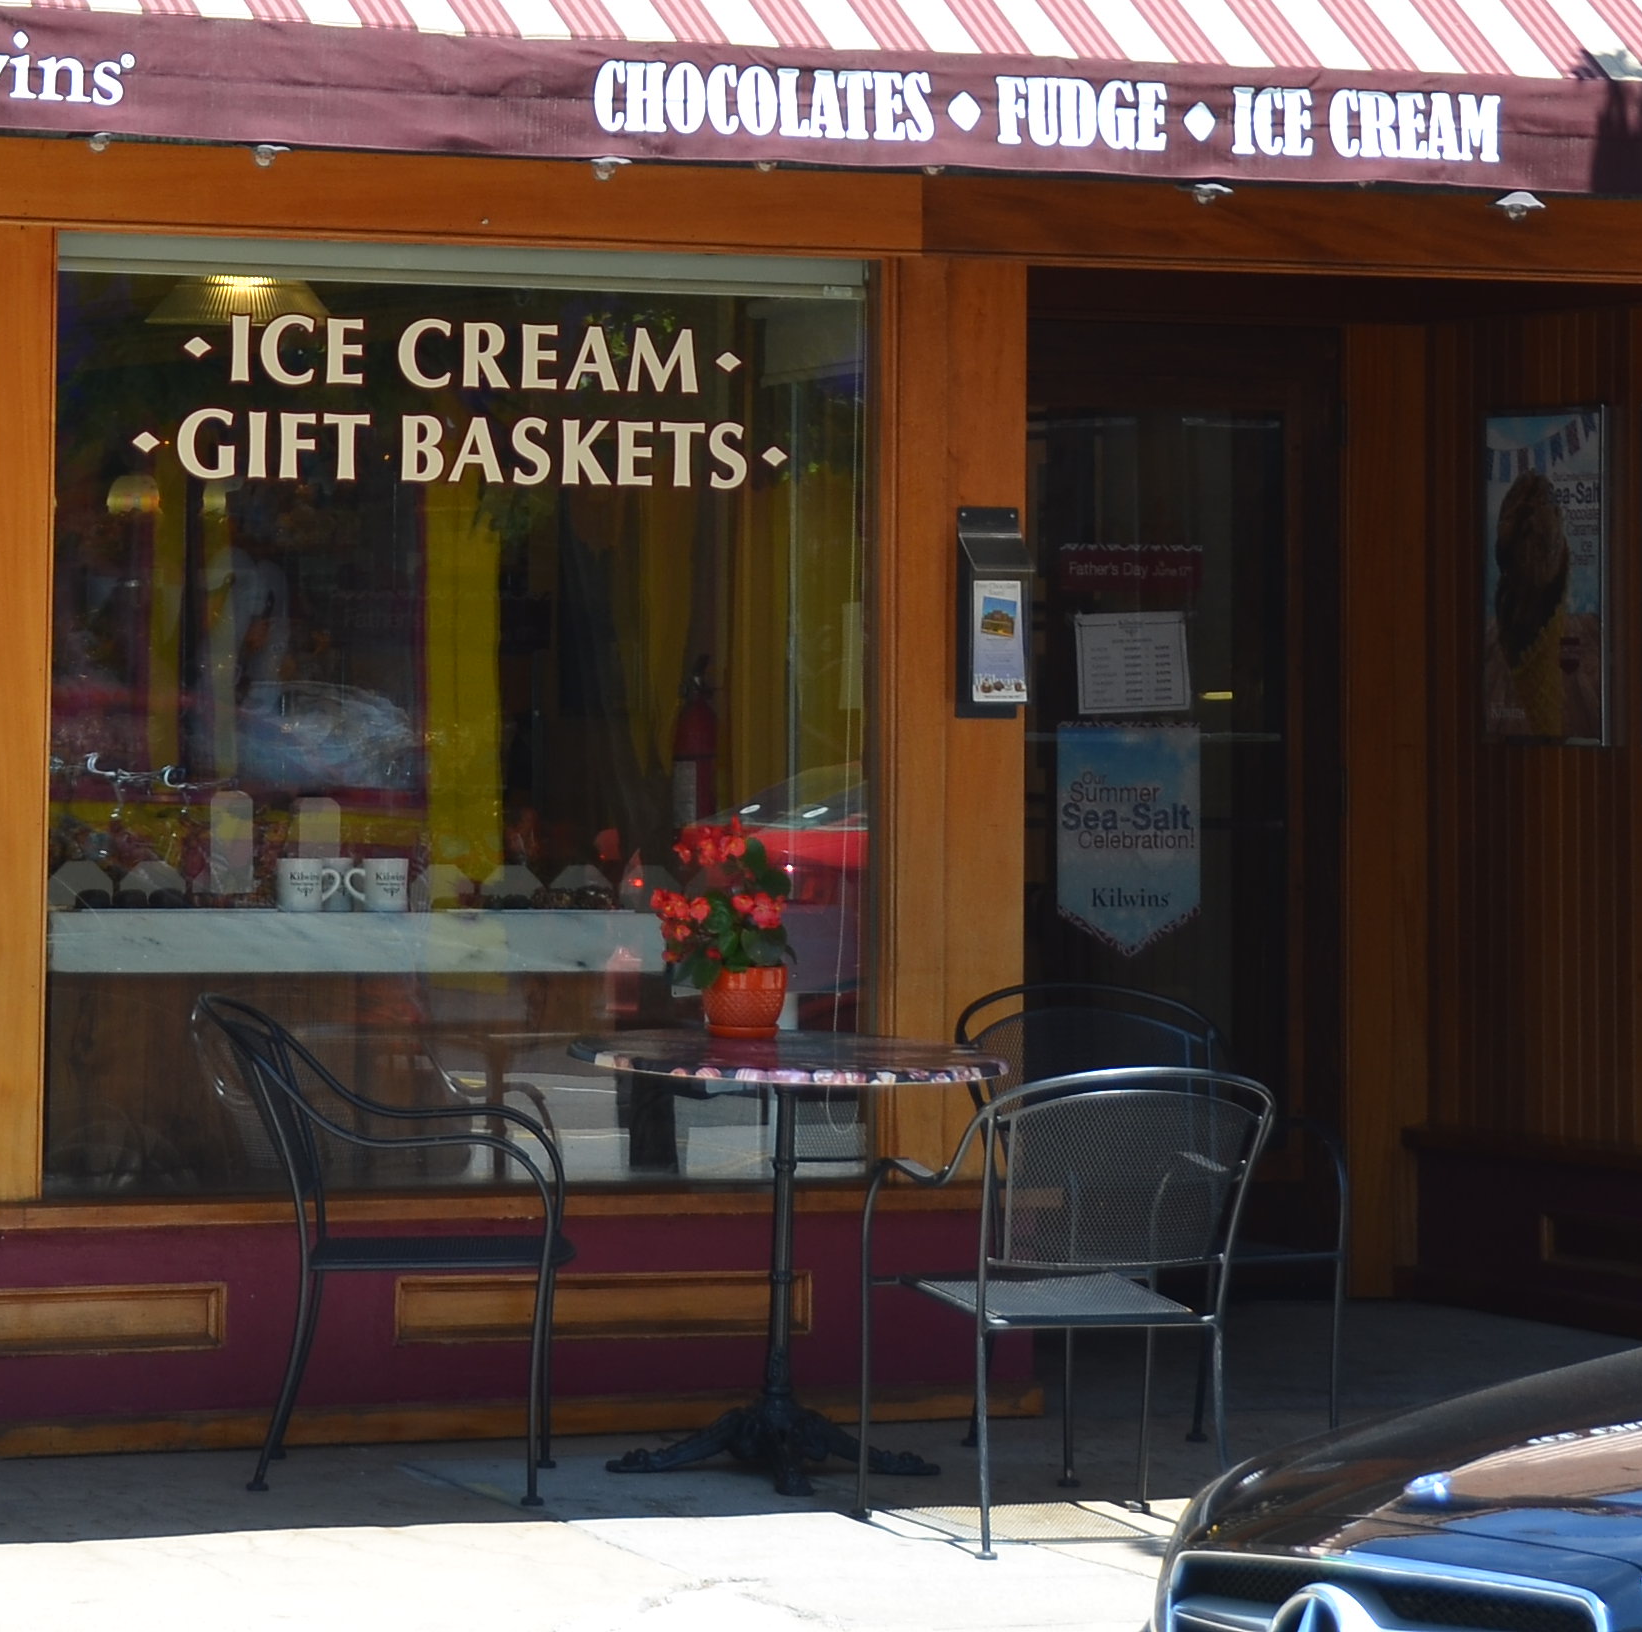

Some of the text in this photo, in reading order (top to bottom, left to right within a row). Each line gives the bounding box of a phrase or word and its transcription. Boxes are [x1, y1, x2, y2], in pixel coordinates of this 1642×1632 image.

[594, 59, 1502, 164] CHOCOLATES FUDGE ICE CREAM
[230, 311, 700, 394] ICE CREAM
[177, 408, 748, 489] GIFT BASKETS
[1068, 561, 1119, 577] Father's
[1123, 562, 1149, 580] Day
[1081, 771, 1108, 785] Our
[1070, 781, 1161, 803] Summer
[1062, 803, 1191, 831] Sea-Salt
[1078, 827, 1195, 849] Celebration!
